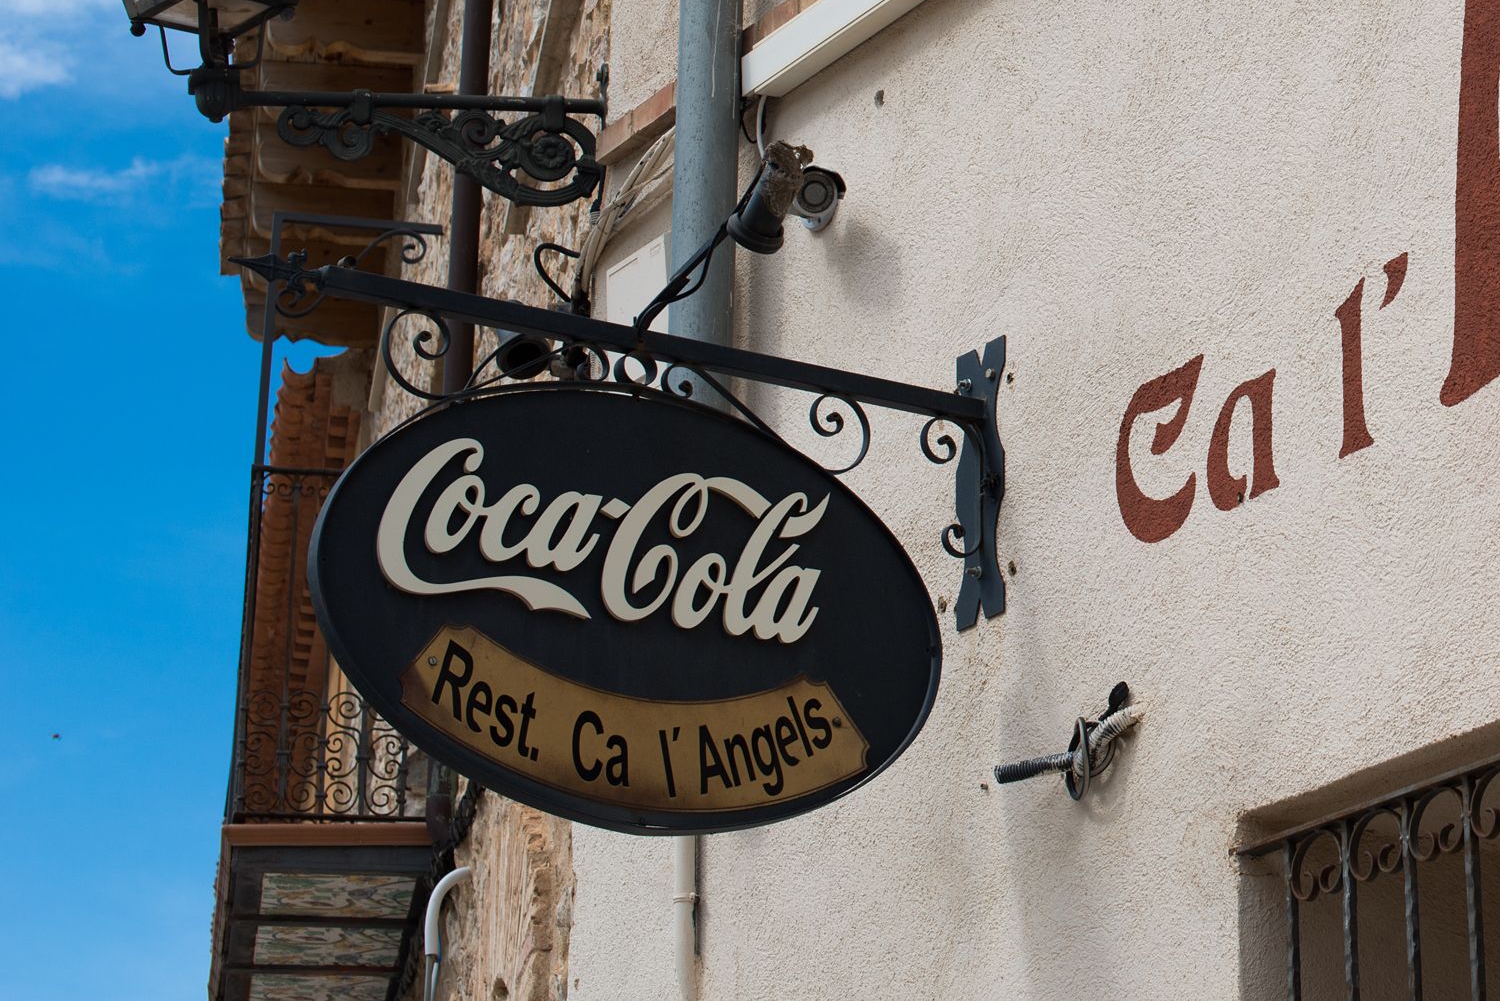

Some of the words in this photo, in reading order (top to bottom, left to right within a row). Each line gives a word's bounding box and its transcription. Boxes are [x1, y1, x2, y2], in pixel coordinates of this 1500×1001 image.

[376, 437, 831, 646] Coca-Cola
[1116, 353, 1280, 544] Ca
[431, 639, 541, 763] Rest.
[571, 710, 631, 788] Ca
